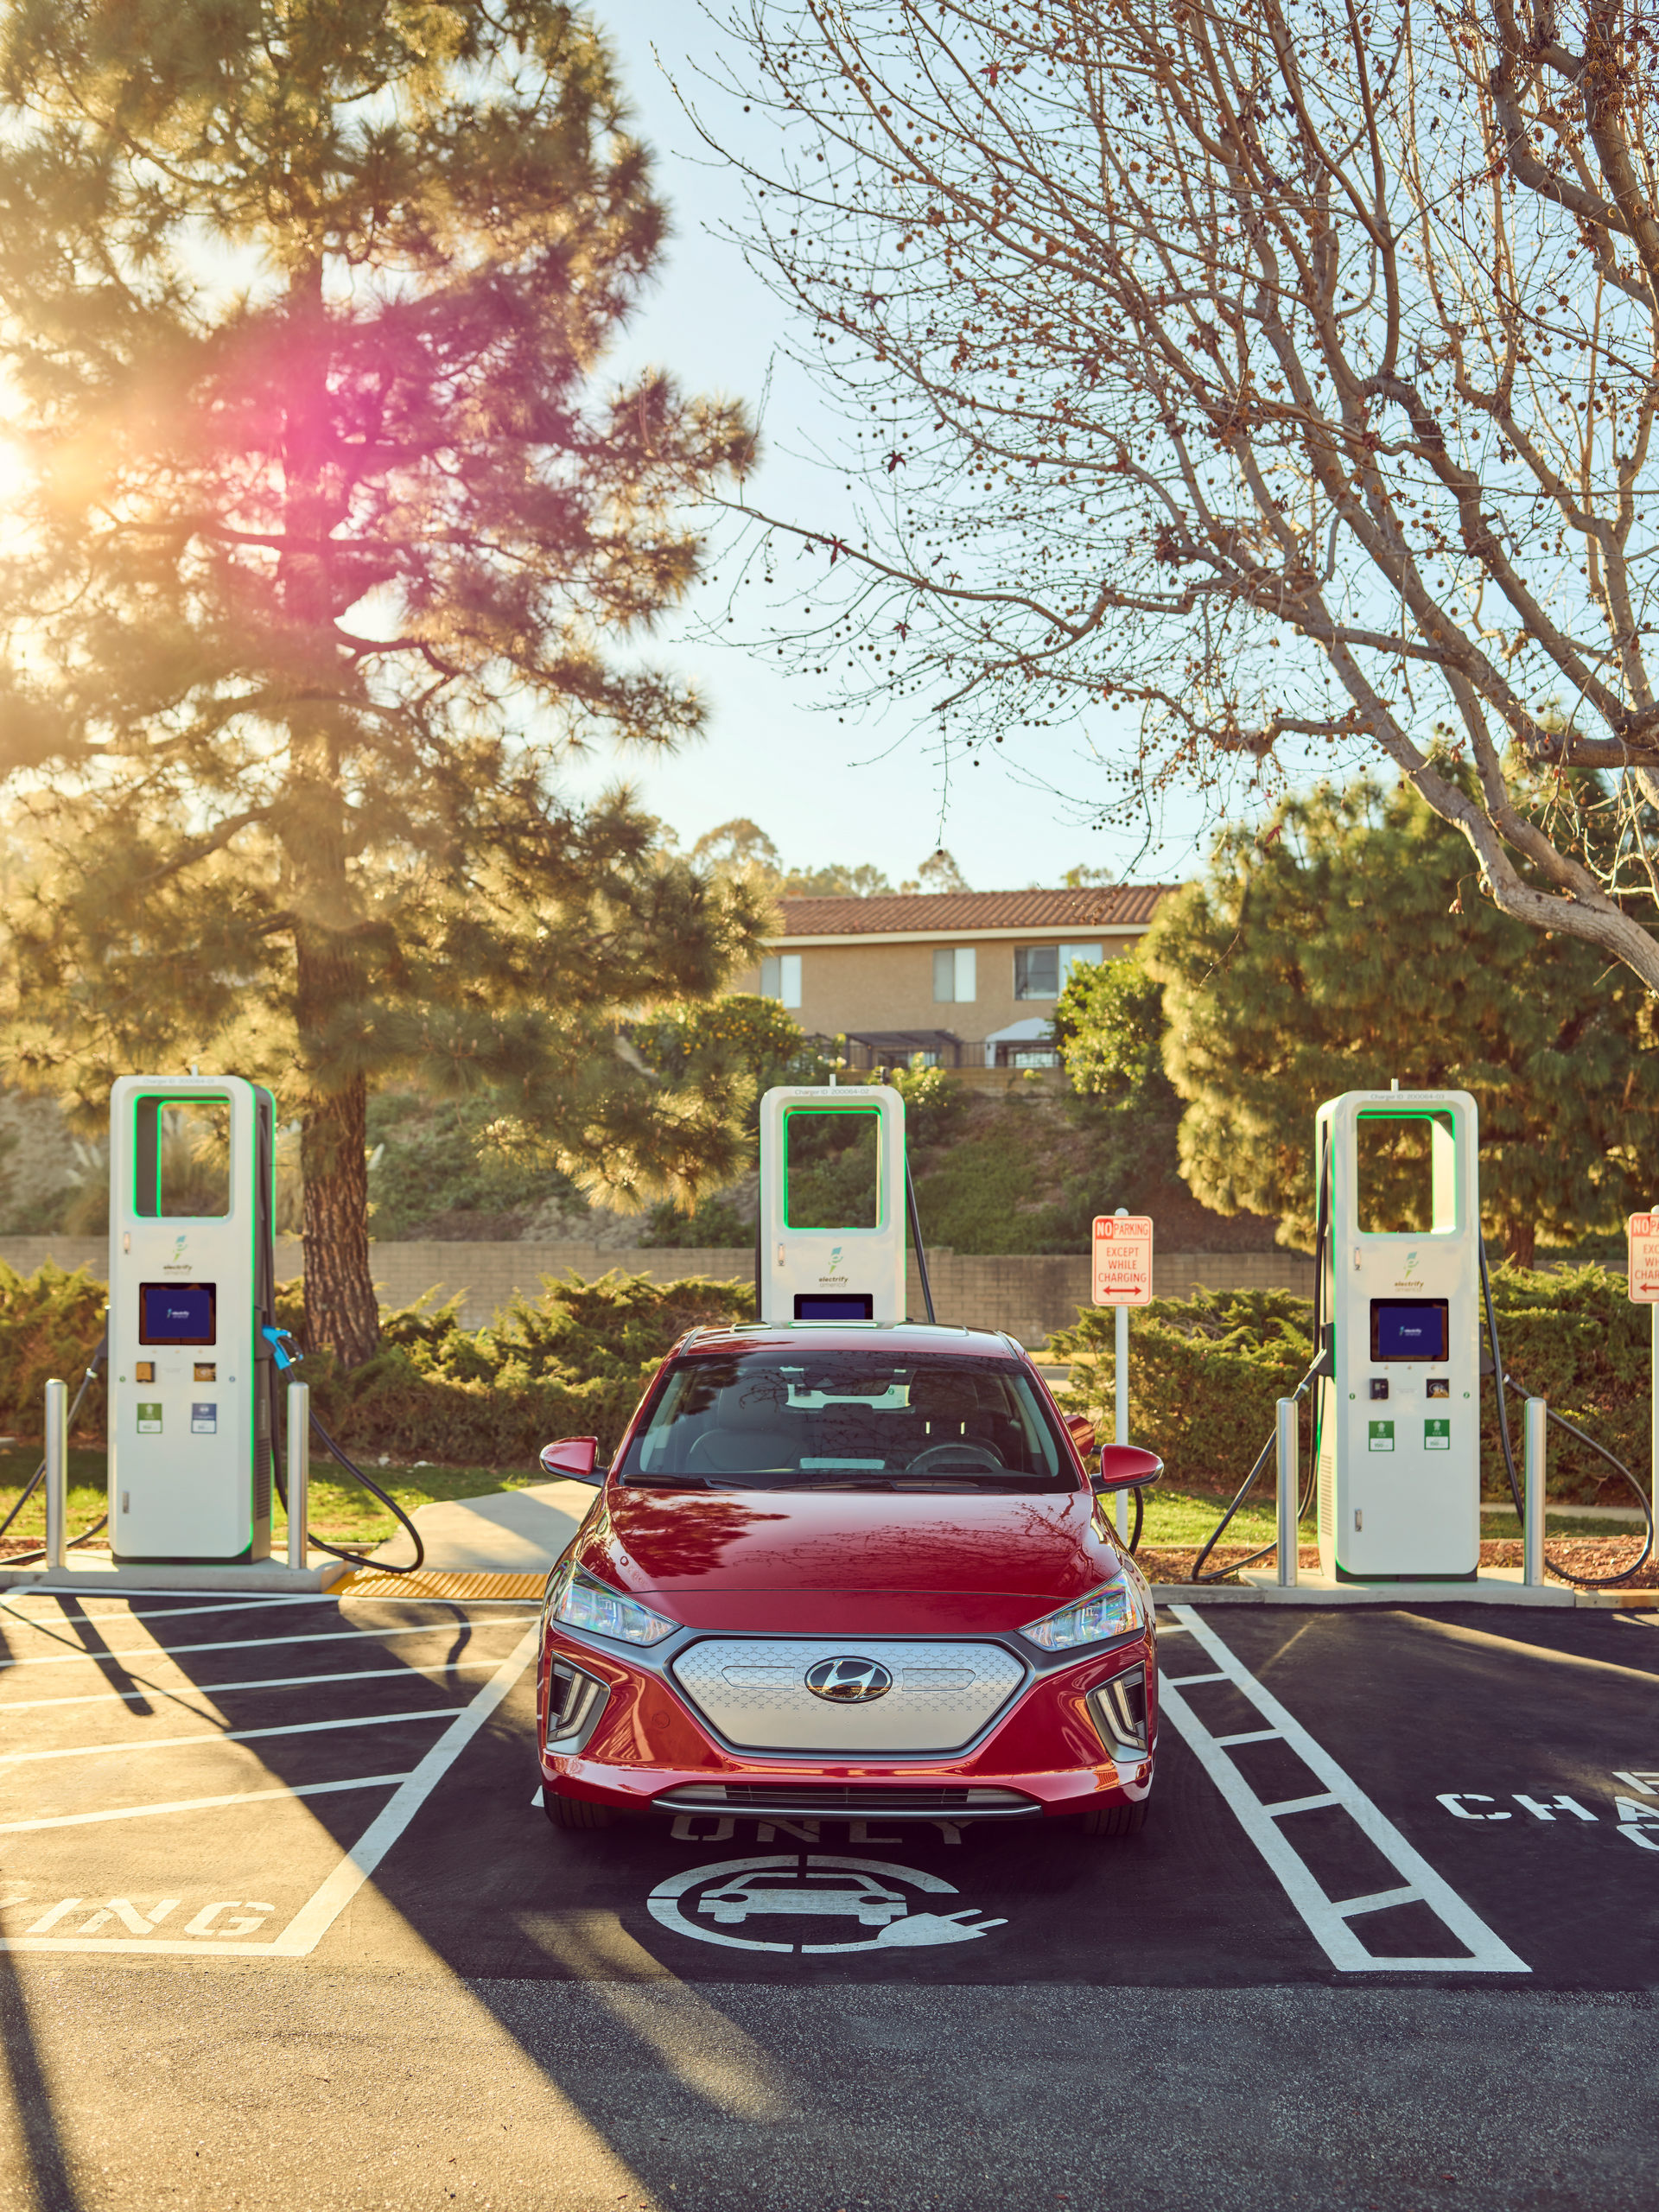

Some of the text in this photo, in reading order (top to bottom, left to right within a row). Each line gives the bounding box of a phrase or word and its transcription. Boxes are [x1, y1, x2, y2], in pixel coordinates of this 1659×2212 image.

[1096, 1221, 1148, 1236] NO PARKING
[1633, 1219, 1649, 1234] NO
[1106, 1247, 1139, 1257] EXCEPT
[1108, 1260, 1137, 1269] WHILE
[818, 1275, 849, 1284] electrify
[1098, 1272, 1147, 1283] CHARGING
[671, 1816, 974, 1845] ONLY
[0, 1897, 276, 1936] ING
